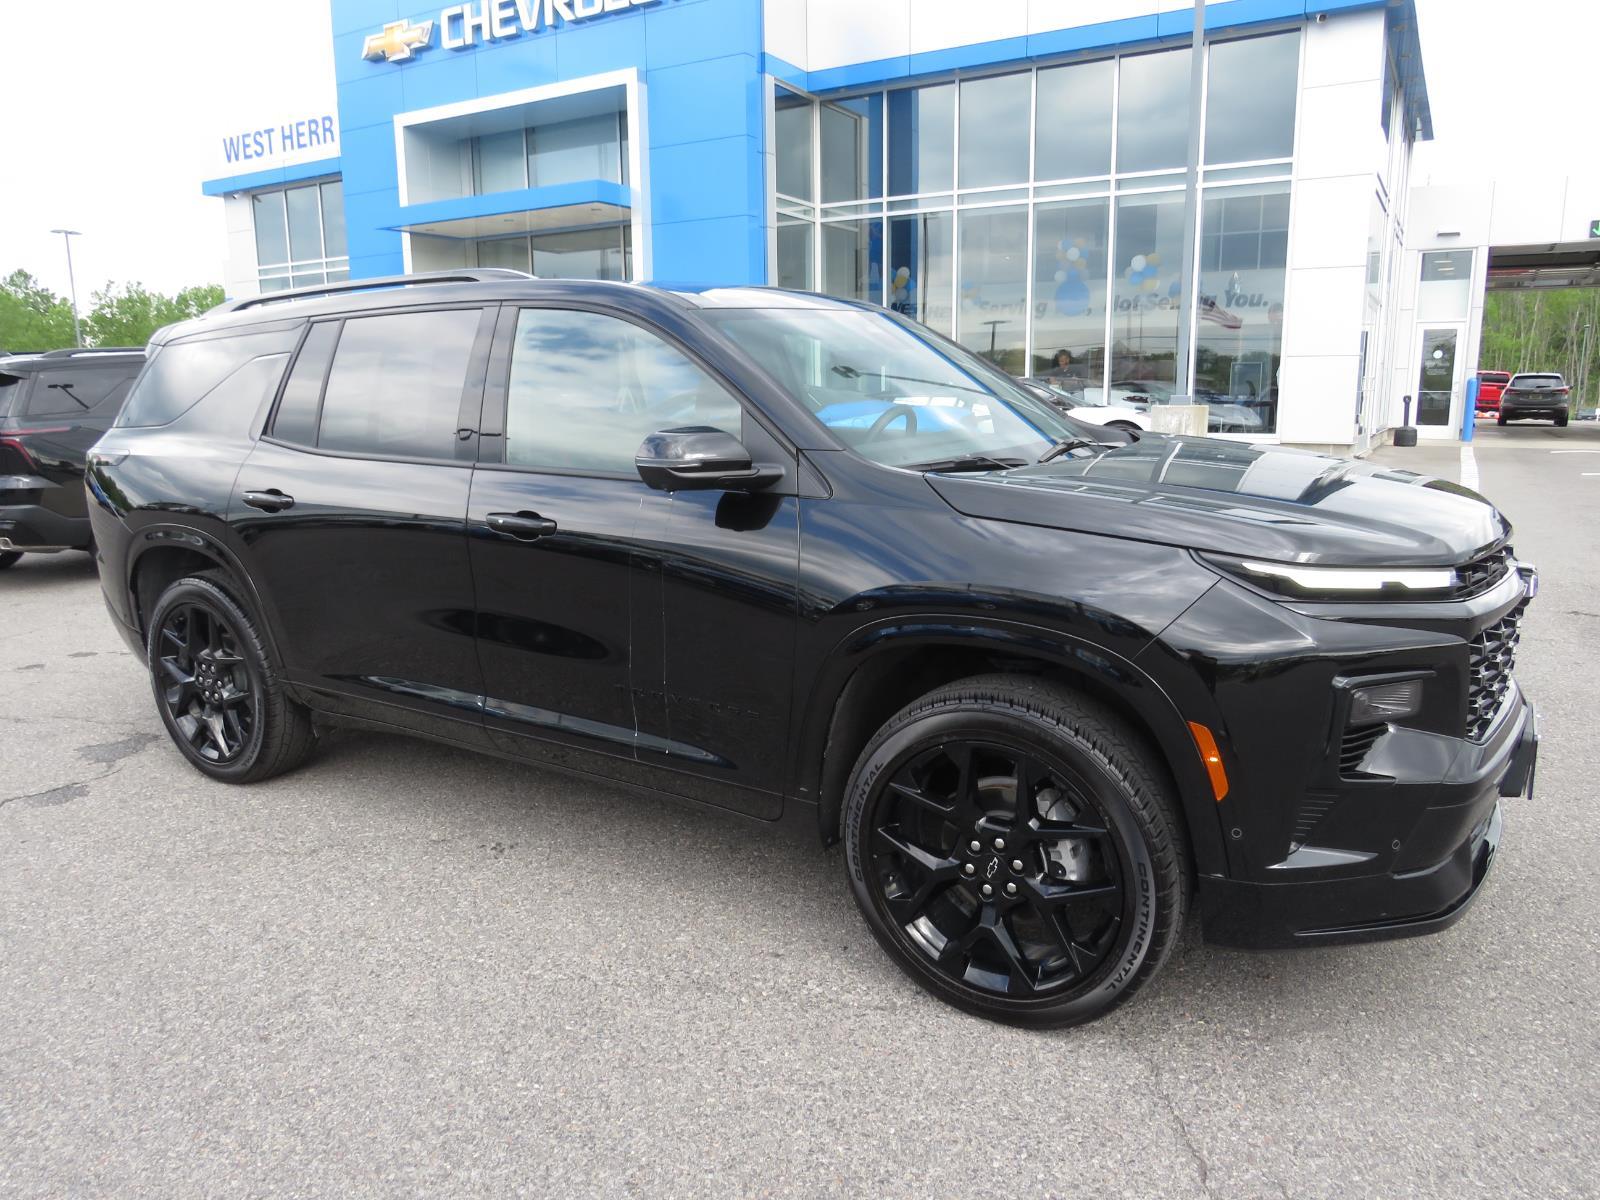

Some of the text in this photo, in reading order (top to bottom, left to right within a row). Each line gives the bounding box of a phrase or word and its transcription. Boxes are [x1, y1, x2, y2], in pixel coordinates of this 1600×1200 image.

[223, 114, 336, 164] WEST HERR
[979, 297, 1049, 320] Servig
[850, 761, 884, 883] CONTINENTAL
[1104, 861, 1152, 993] CONTINENTAL
